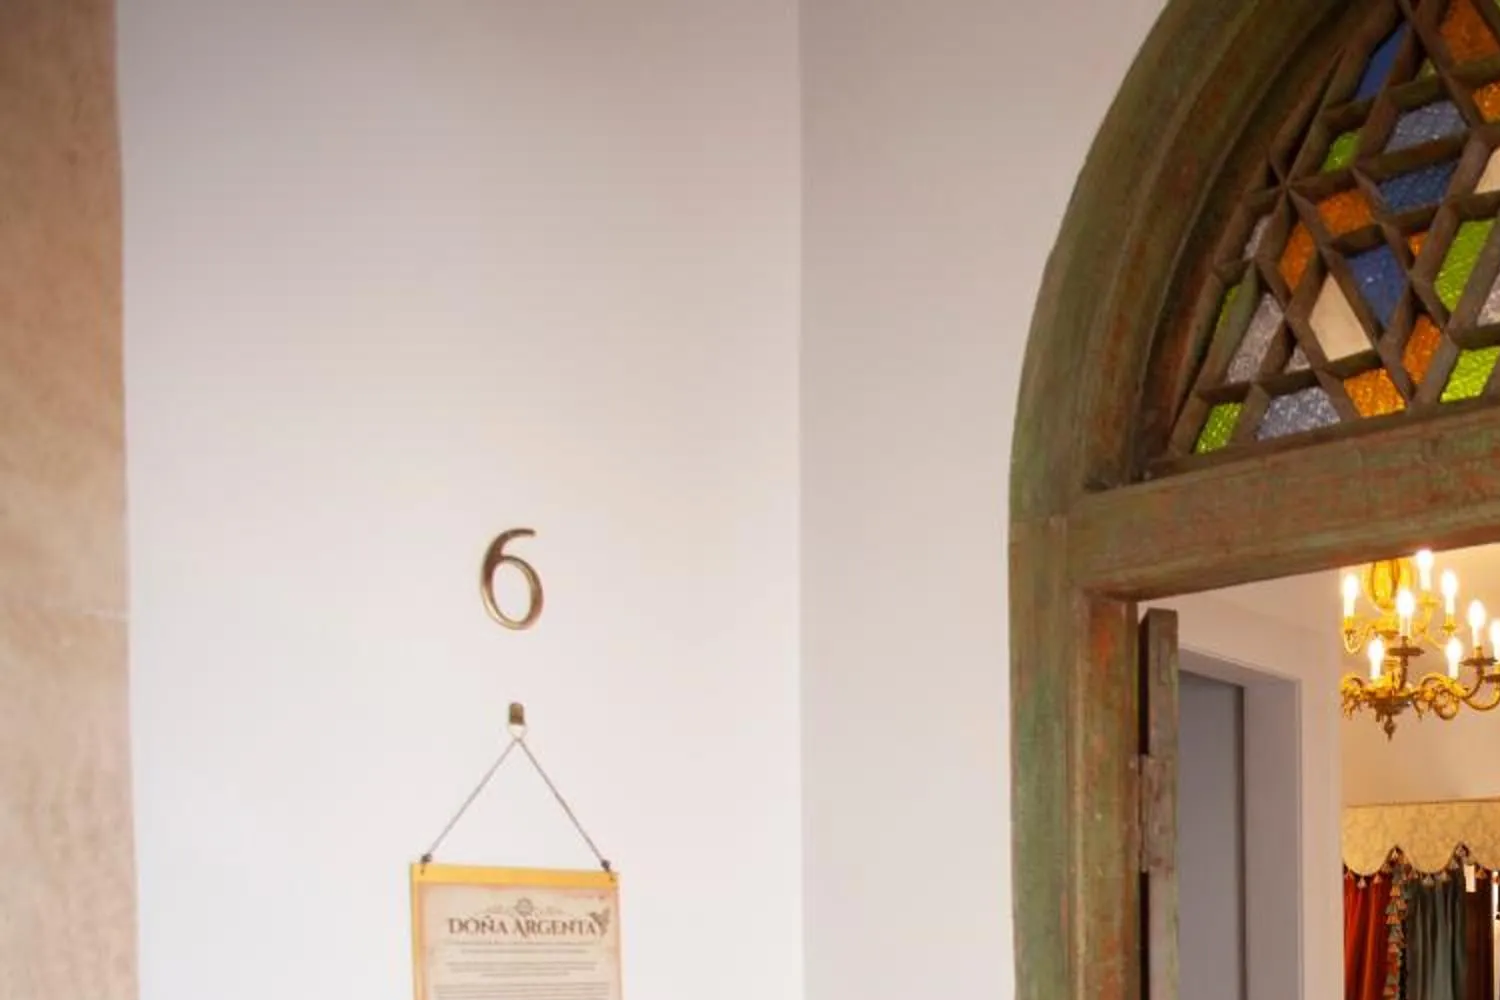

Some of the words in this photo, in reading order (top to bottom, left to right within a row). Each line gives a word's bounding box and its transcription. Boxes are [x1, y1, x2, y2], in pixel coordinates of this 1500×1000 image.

[480, 528, 544, 630] 6
[448, 914, 508, 935] DOÑA
[513, 917, 597, 938] ARGENTA
